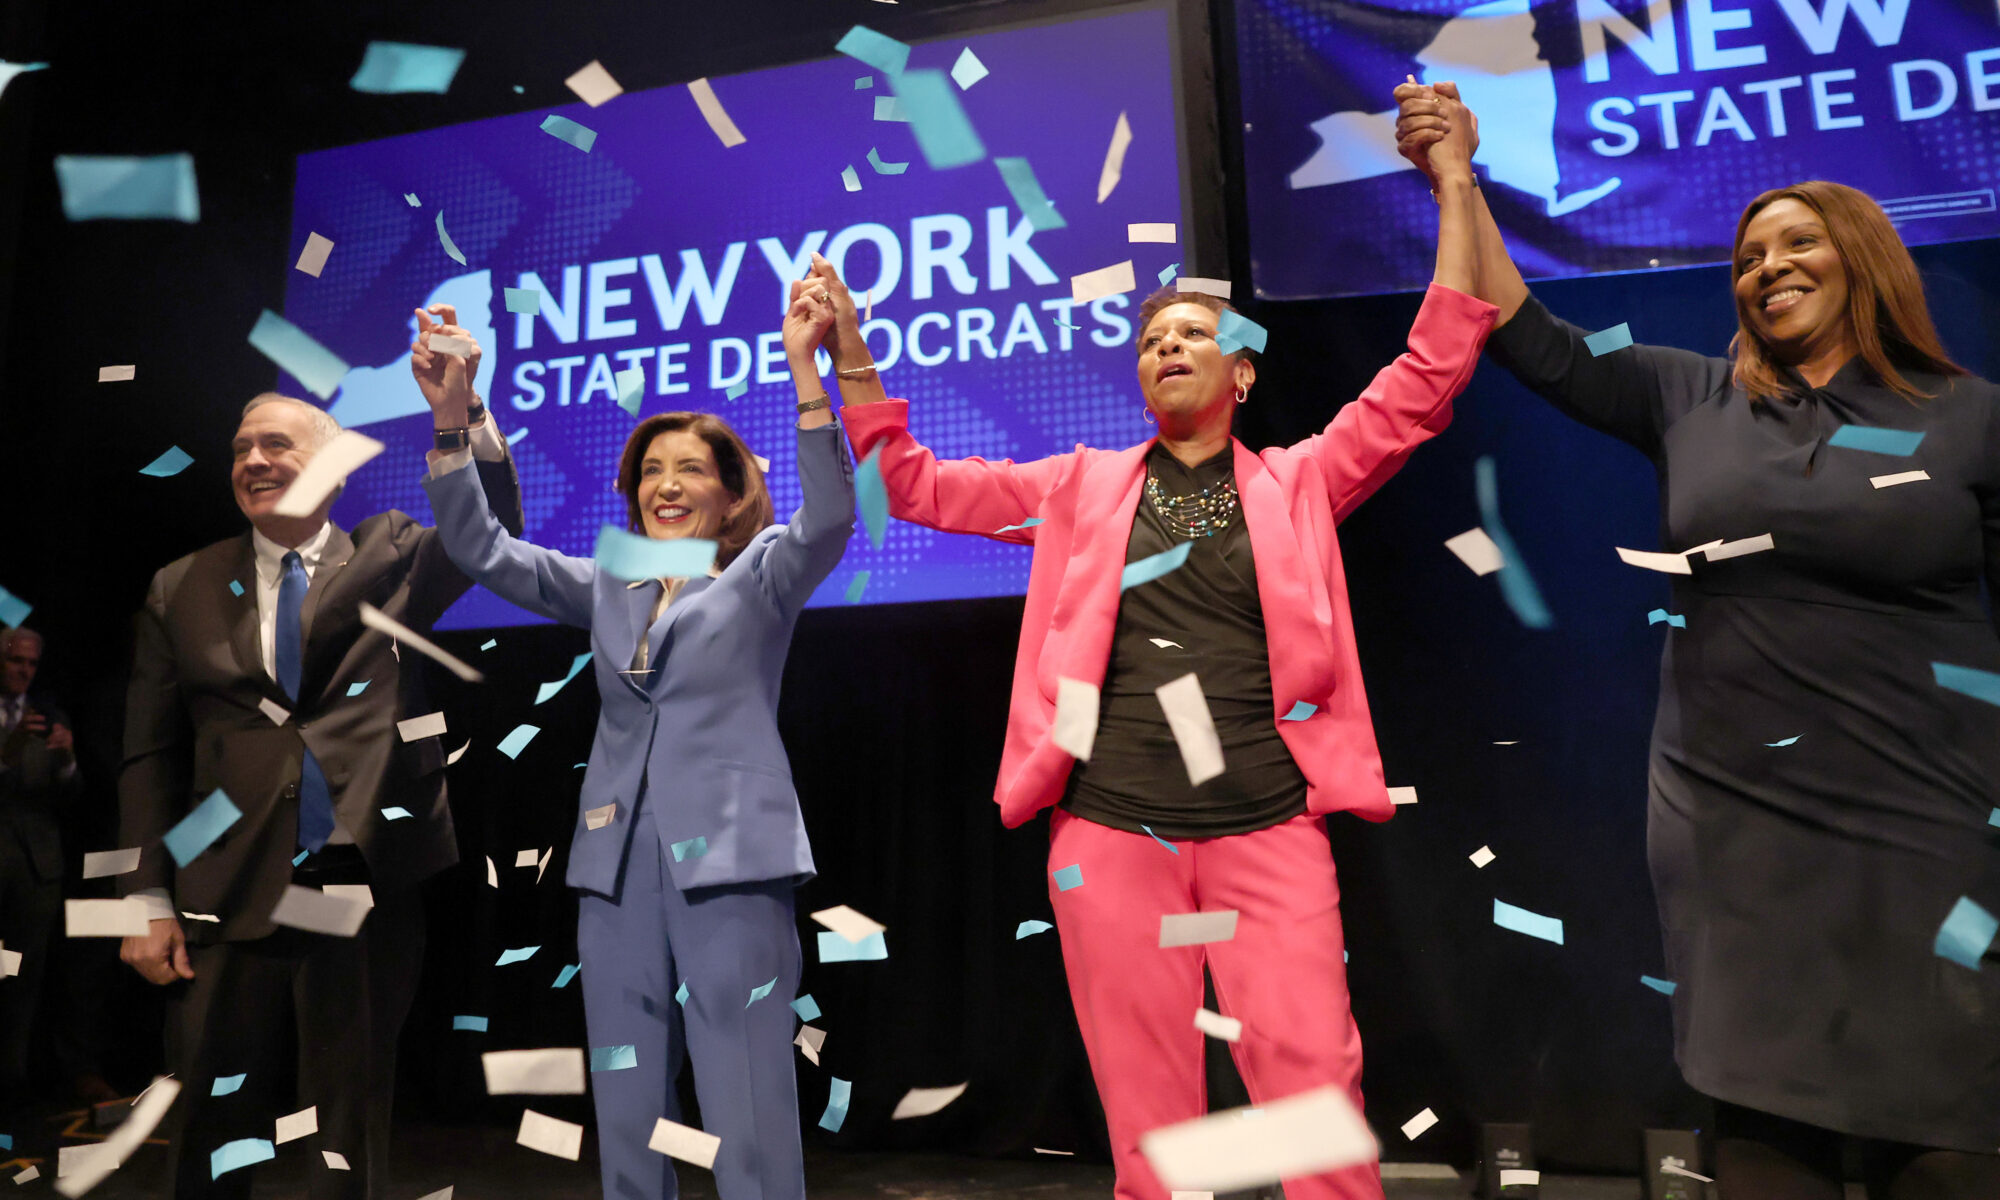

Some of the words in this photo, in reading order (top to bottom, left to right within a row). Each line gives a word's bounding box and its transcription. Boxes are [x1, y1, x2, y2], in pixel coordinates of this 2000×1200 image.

[1577, 0, 1910, 83] NEW
[1588, 69, 1864, 156] STATE
[514, 242, 747, 349] NEW
[757, 206, 1059, 316] YORK
[511, 343, 690, 411] STATE
